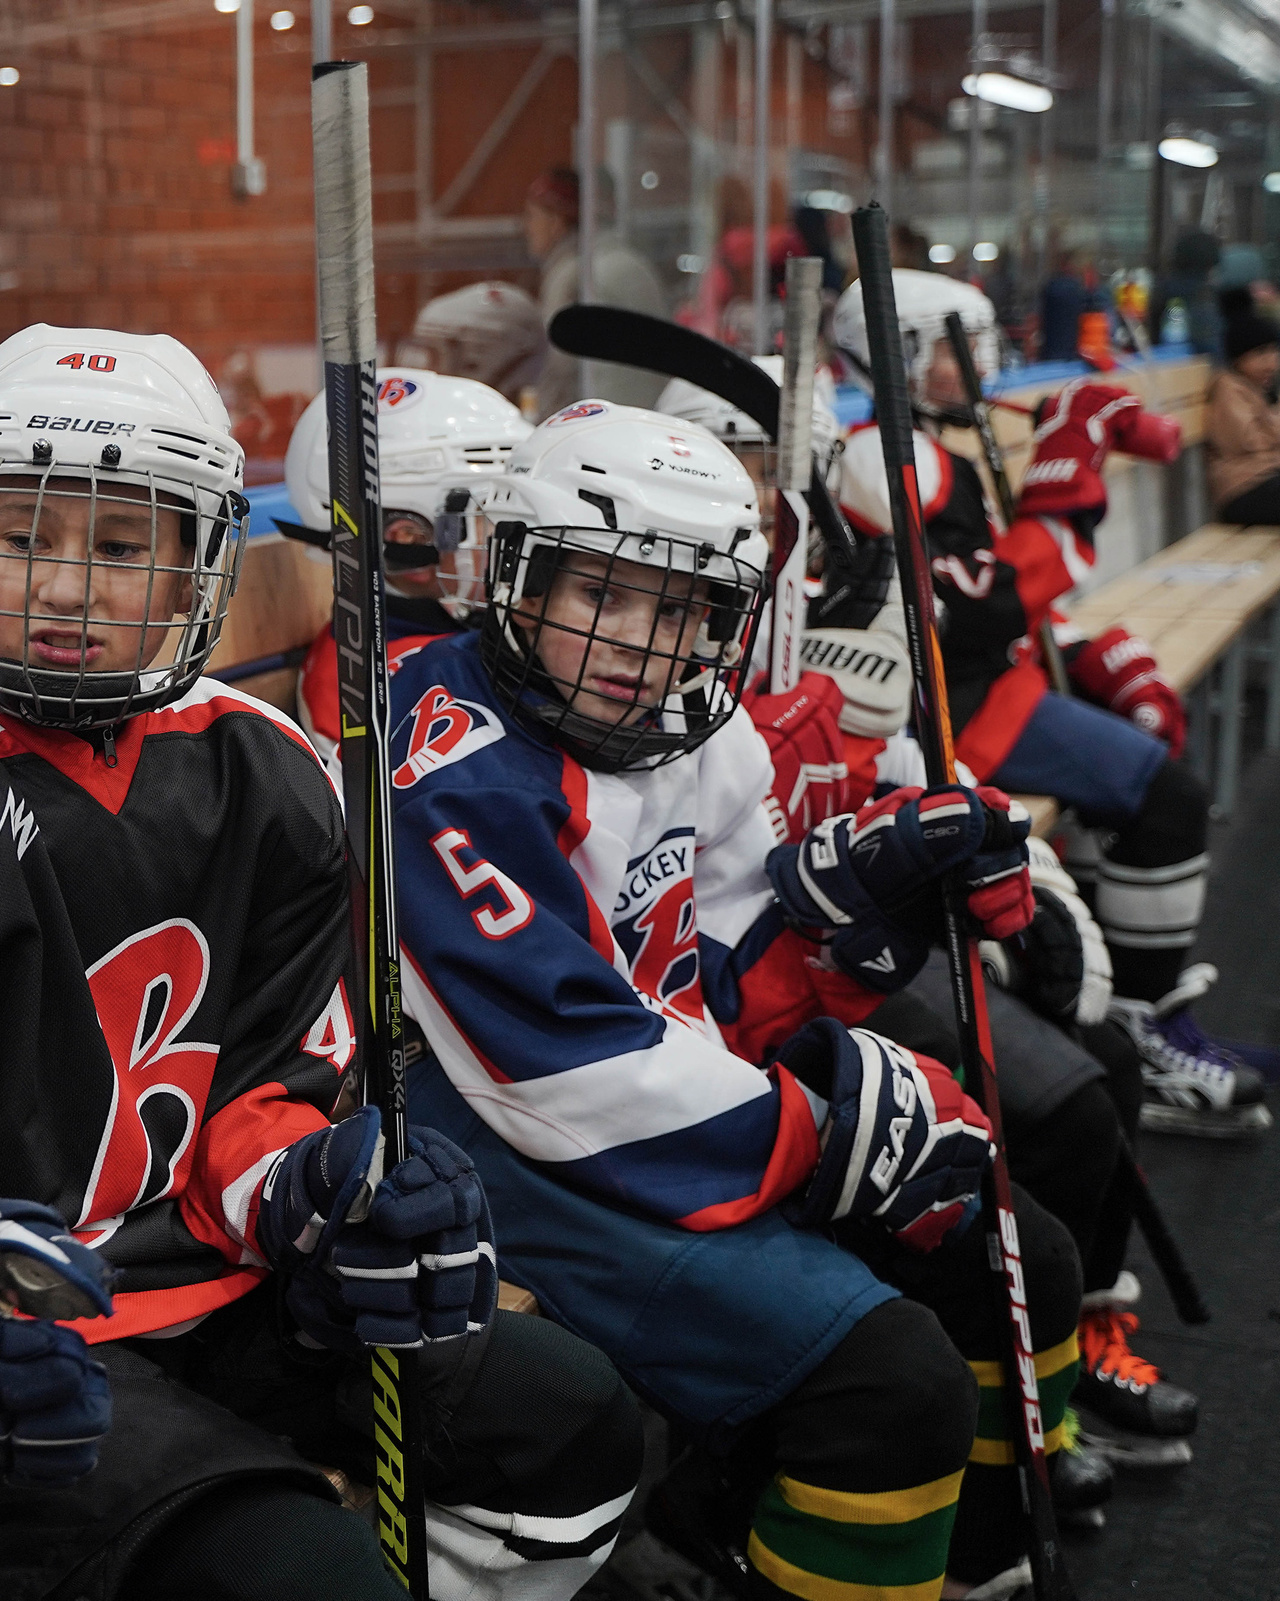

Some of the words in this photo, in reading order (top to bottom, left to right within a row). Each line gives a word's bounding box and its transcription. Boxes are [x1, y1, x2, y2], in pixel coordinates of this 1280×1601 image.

[56, 353, 117, 373] 40
[26, 415, 136, 437] BAUER
[373, 594, 382, 653] BACKSTROM
[429, 827, 536, 941] 5
[613, 847, 687, 912] OCKEY
[389, 962, 401, 1039] ALPHA
